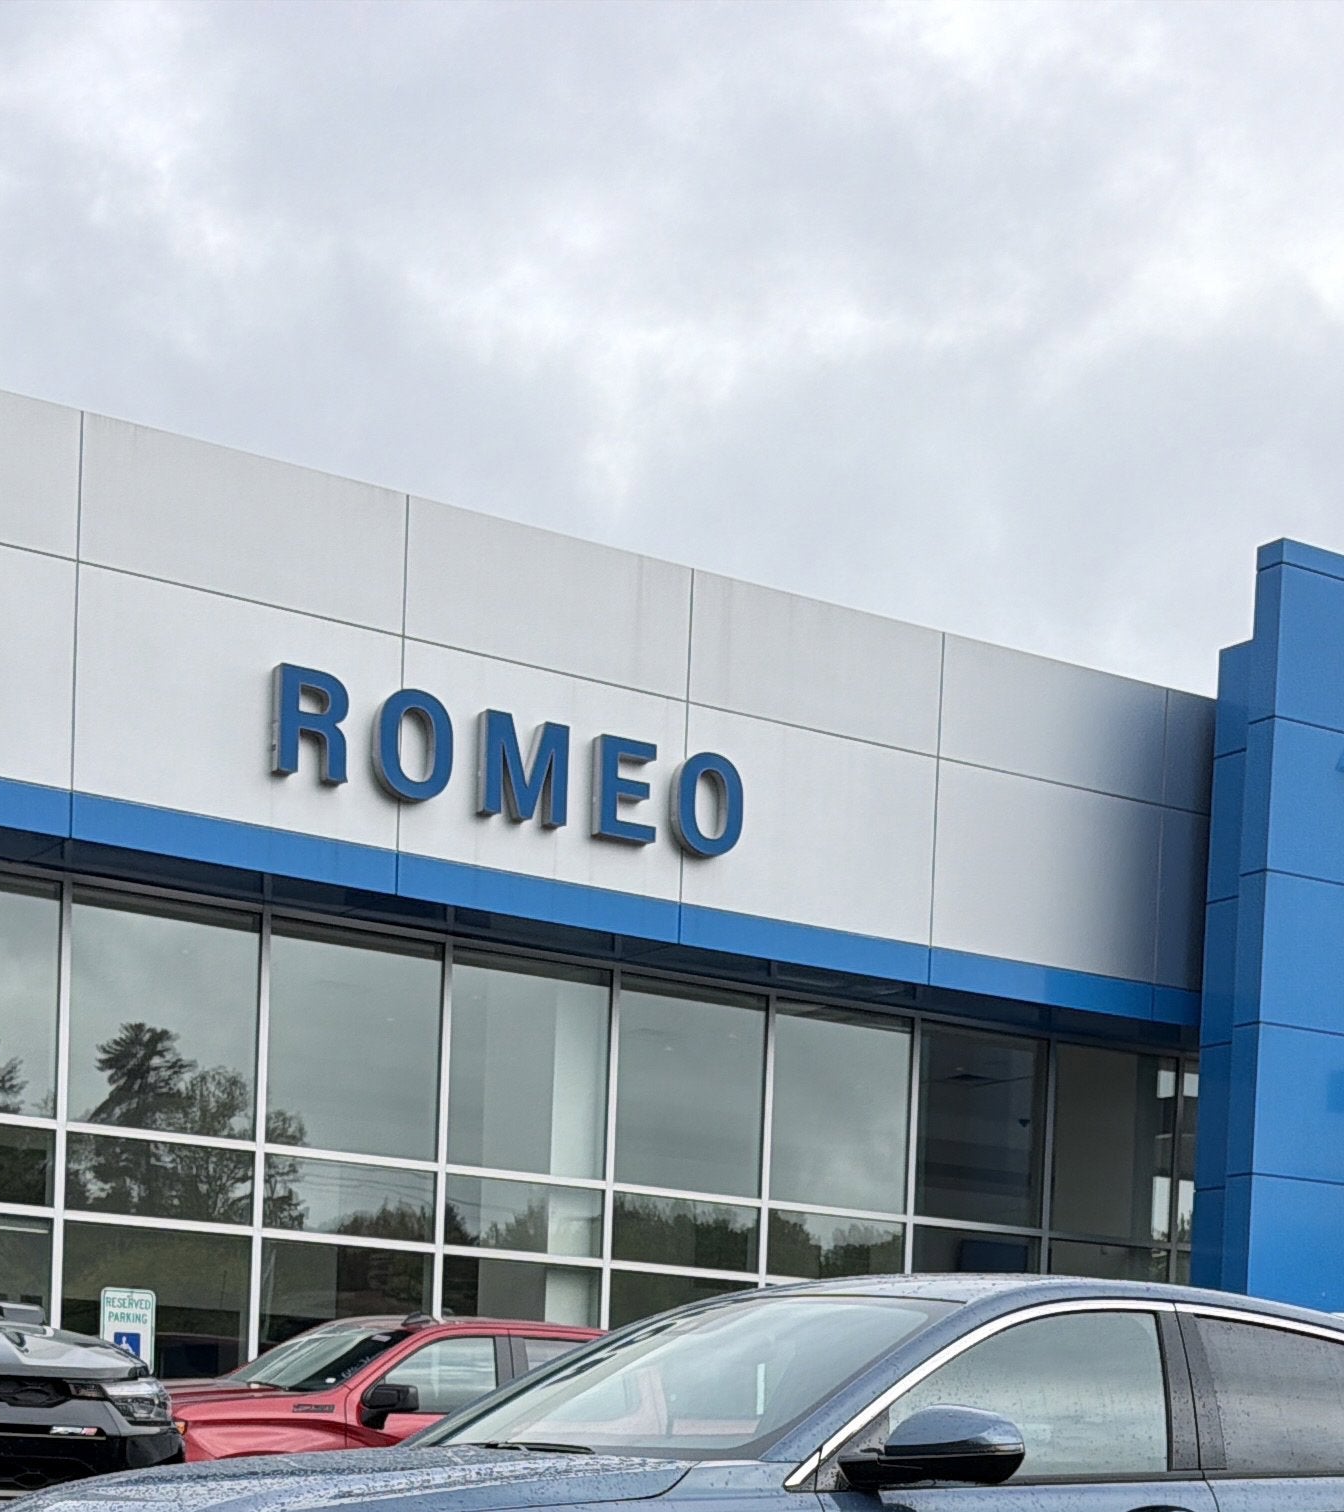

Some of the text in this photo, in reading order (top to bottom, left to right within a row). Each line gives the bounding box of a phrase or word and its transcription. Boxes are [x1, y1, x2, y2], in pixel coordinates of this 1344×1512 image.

[271, 661, 744, 858] ROMEO
[105, 1297, 152, 1311] RESERVED
[108, 1311, 149, 1325] PARKING
